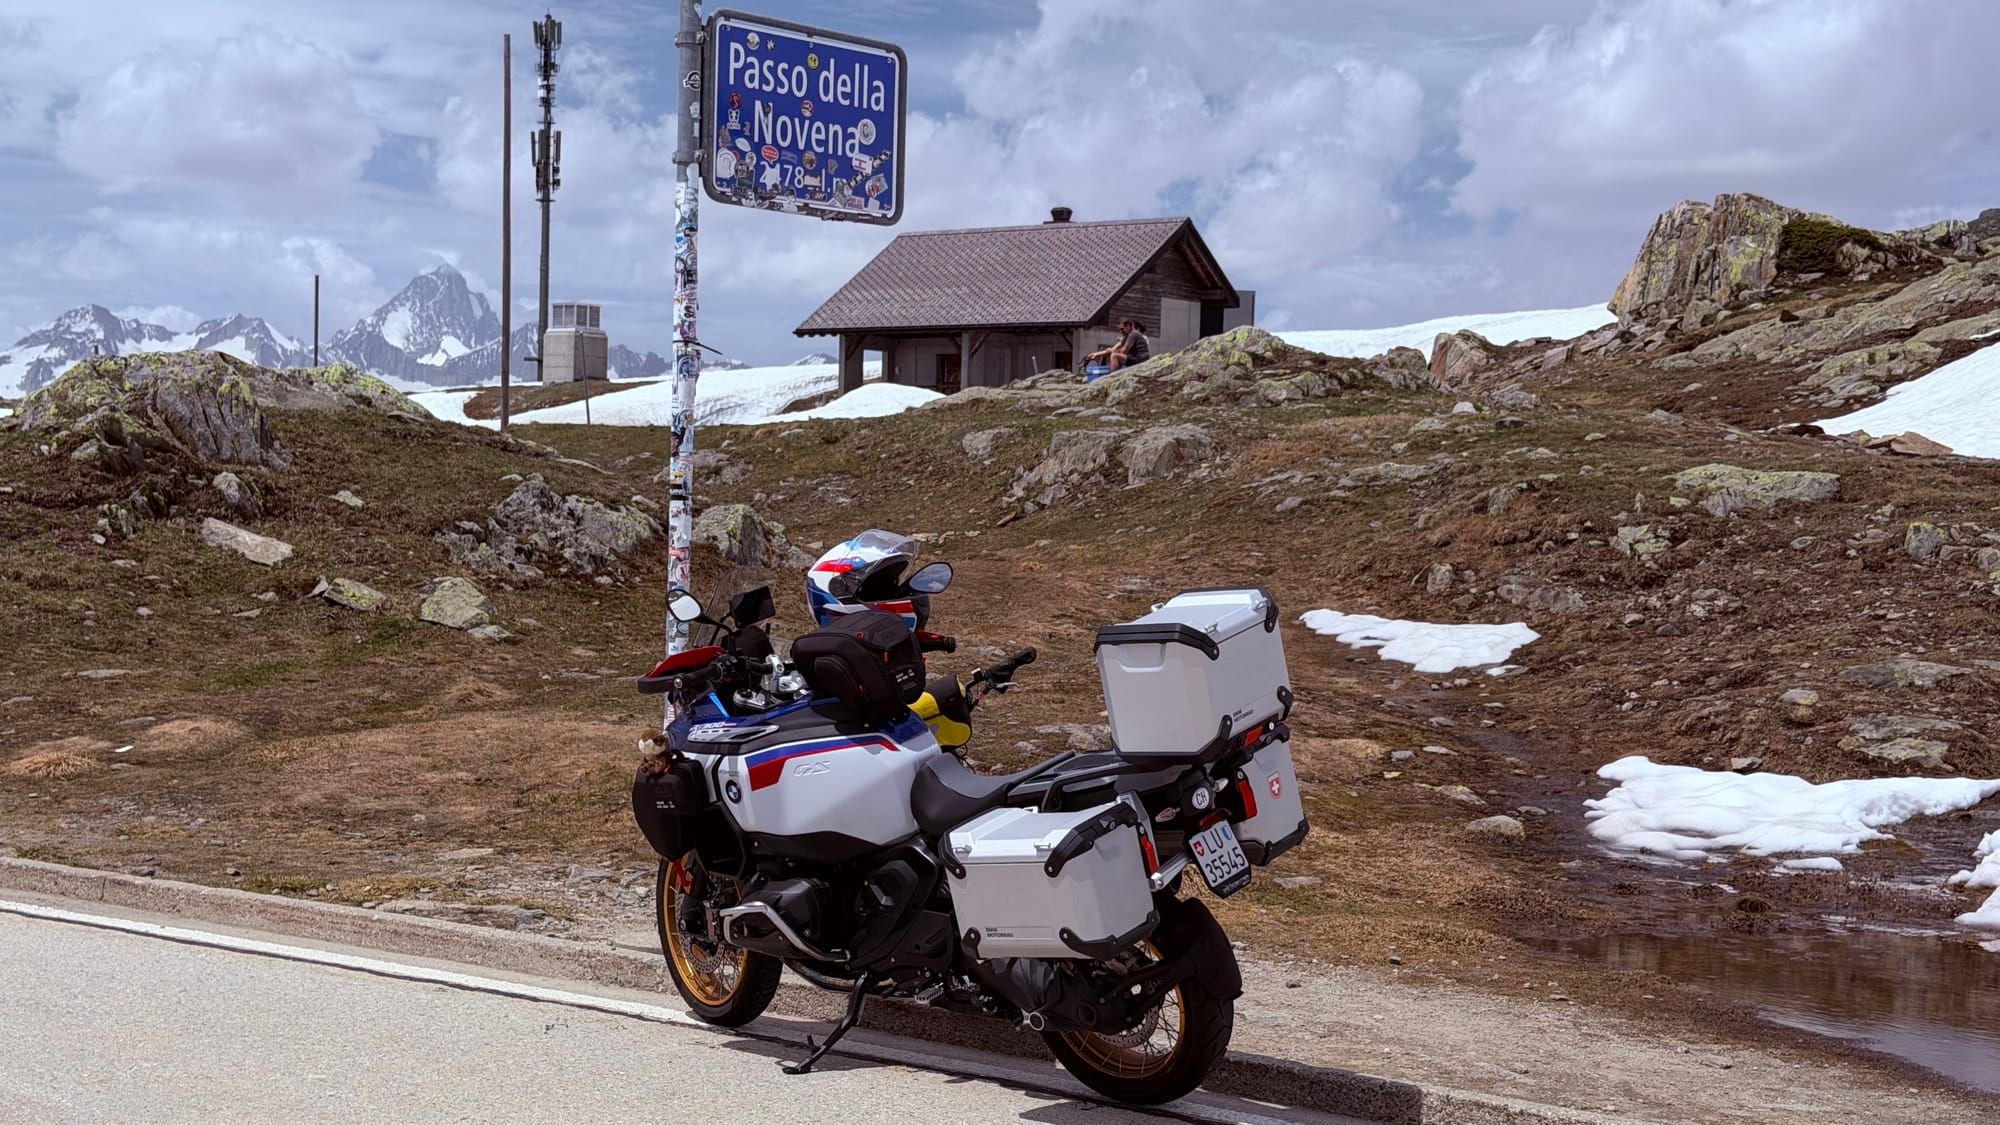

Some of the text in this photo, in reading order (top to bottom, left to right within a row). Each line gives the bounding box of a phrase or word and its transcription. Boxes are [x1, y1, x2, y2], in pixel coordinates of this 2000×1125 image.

[729, 42, 885, 112] Passo della
[754, 99, 860, 157] Novena
[1195, 790, 1208, 806] CH
[1202, 828, 1224, 855] LU
[1205, 846, 1246, 883] 35545
